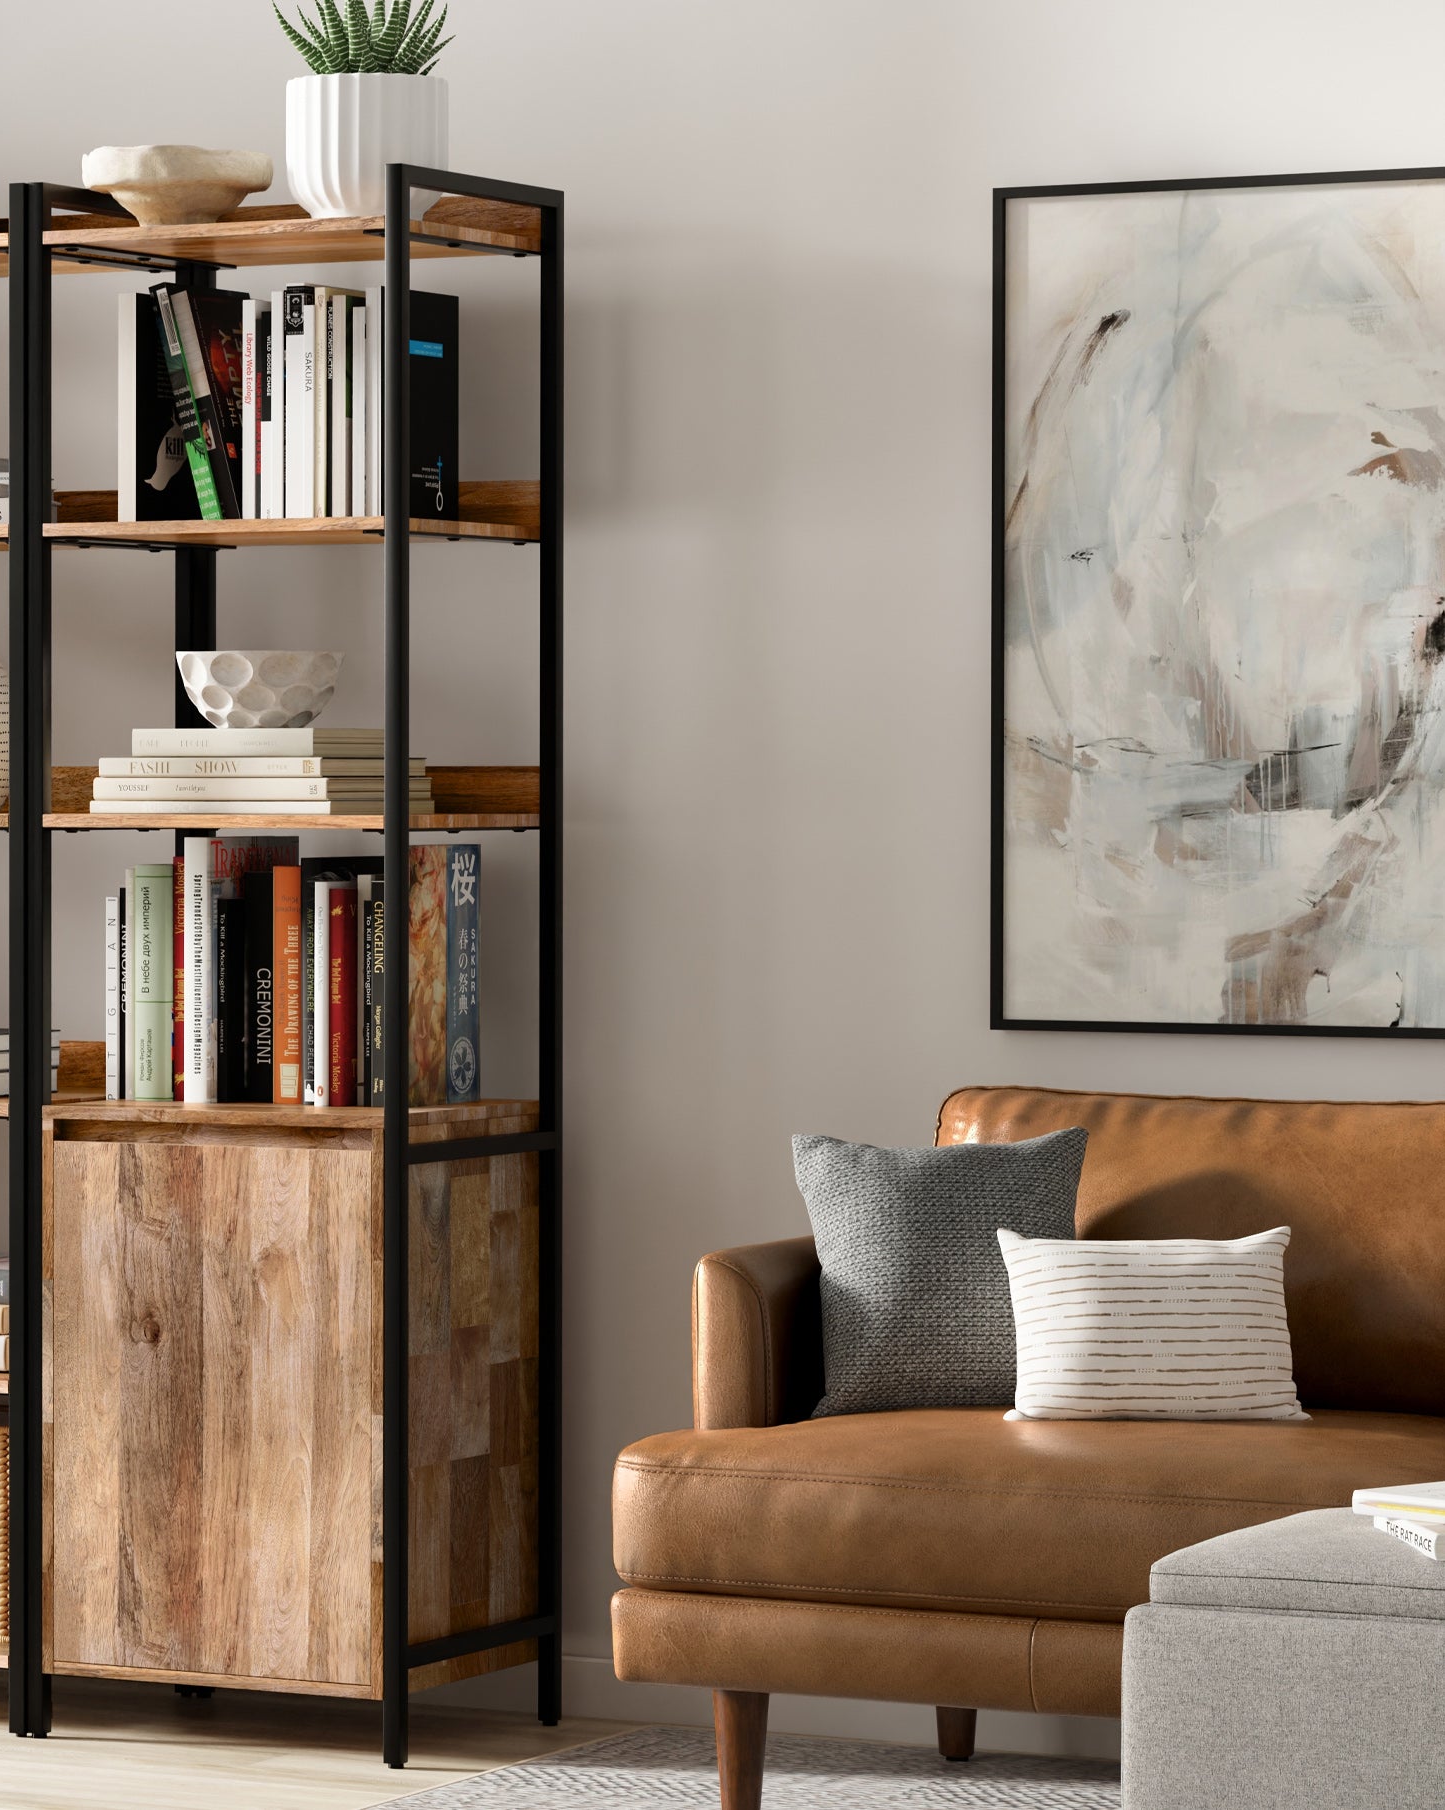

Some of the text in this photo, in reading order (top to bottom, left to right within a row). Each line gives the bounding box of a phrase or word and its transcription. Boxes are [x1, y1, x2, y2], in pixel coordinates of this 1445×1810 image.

[244, 332, 253, 405] Library Web Ecology
[305, 351, 313, 392] SAKURA
[194, 762, 238, 774] SHOW
[451, 852, 476, 907] 桜
[140, 886, 152, 930] империй
[219, 914, 226, 924] To
[366, 915, 372, 926] To
[141, 934, 152, 957] двух
[374, 901, 384, 973] CHANGELING
[140, 960, 150, 984] небе
[284, 924, 299, 1056] THE DRAWING OF THE THREE
[458, 928, 469, 1015] 春の祭典
[108, 898, 116, 1100] PITIGLIANI
[257, 968, 272, 1064] CREMONINI
[374, 1005, 382, 1050] Morgan Gallagher
[331, 1032, 341, 1094] Victoria Mosley
[1386, 1521, 1432, 1552] THE RAT RACE
